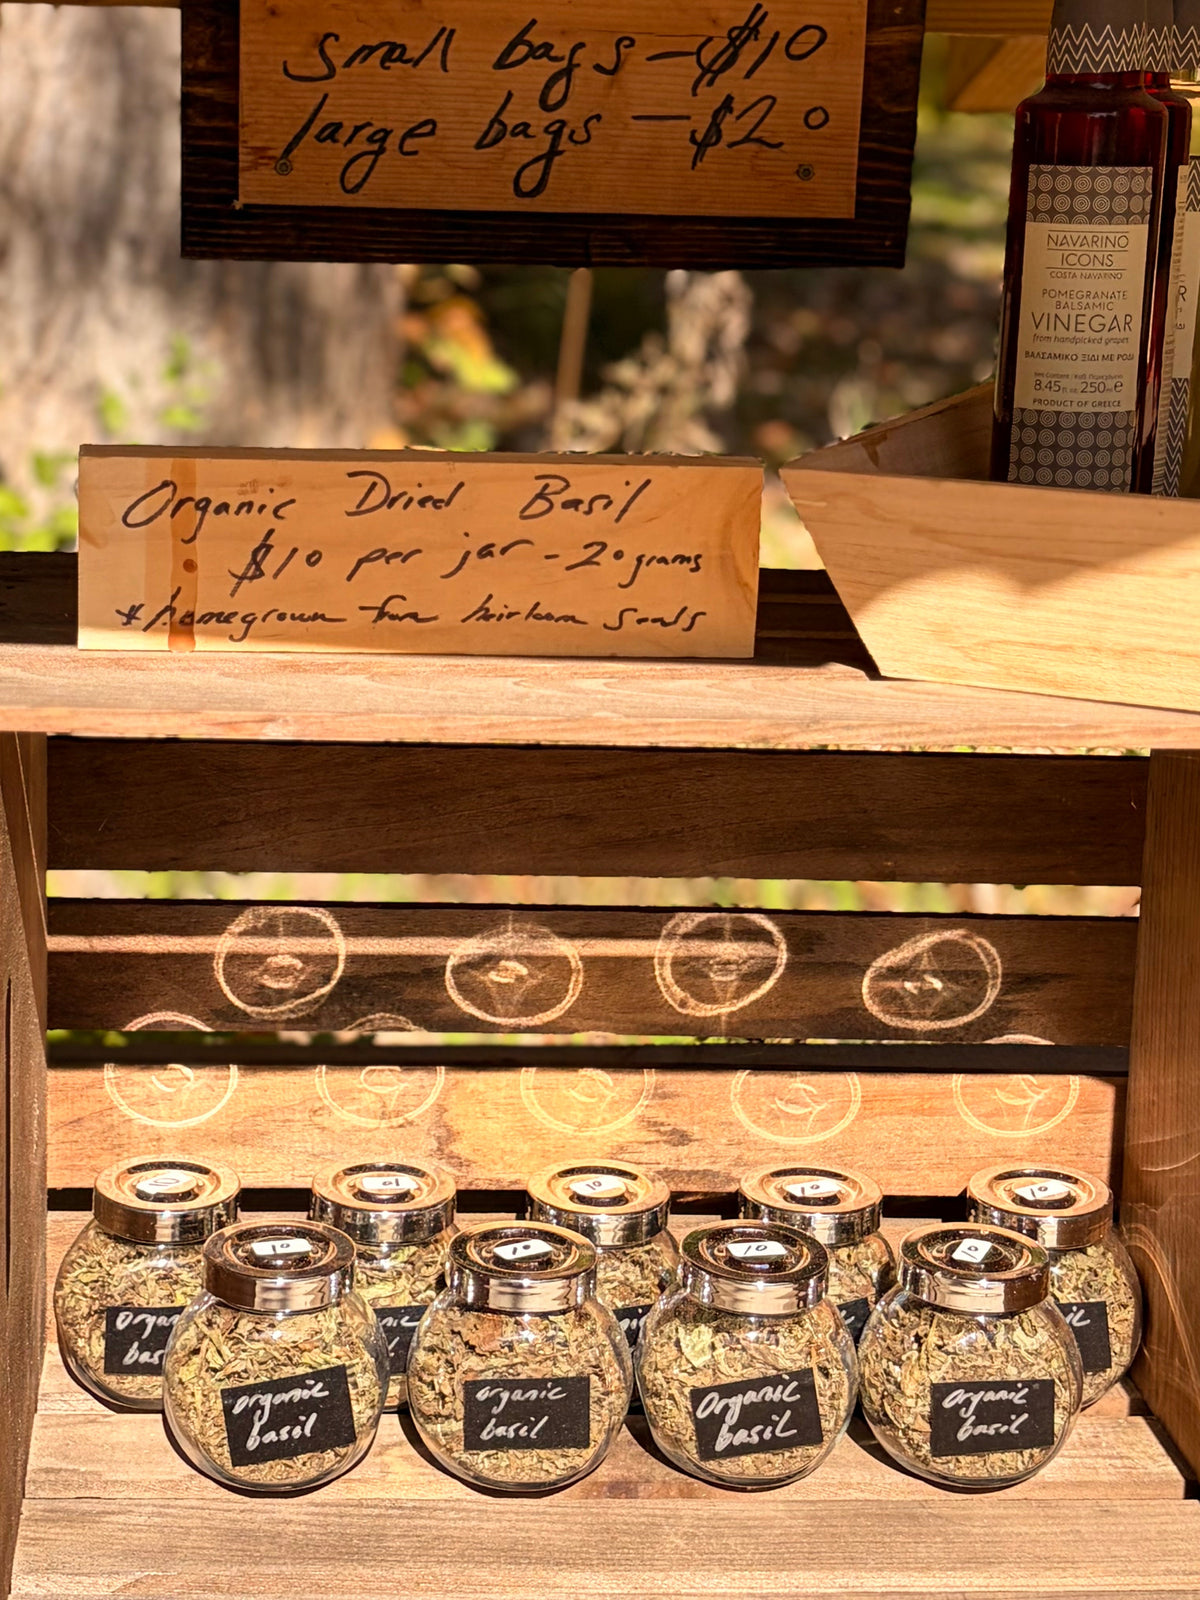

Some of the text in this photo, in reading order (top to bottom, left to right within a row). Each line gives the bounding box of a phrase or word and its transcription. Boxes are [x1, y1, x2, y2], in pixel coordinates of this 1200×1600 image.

[492, 18, 636, 112] bags
[474, 90, 603, 199] bags
[1047, 234, 1130, 249] NAVARINO
[1061, 252, 1114, 267] ICONS
[1049, 271, 1123, 280] COSTA NAVARINO
[1042, 288, 1128, 301] POMEGRANATE
[1055, 300, 1114, 311] BALSAMIC
[1031, 311, 1133, 333] VINEGAR
[1033, 333, 1052, 344] from
[1054, 335, 1103, 345] handpicked
[1033, 378, 1061, 393] 8.45
[1033, 398, 1074, 407] PRODUCT
[1091, 400, 1121, 408] GREECE
[121, 470, 652, 544] Organic Dried Basil
[227, 527, 323, 598] $10
[345, 547, 423, 582] per
[440, 531, 535, 579] jar
[148, 1176, 181, 1188] 10
[586, 1179, 603, 1191] 10
[800, 1183, 821, 1195] 10
[1030, 1185, 1049, 1199] 10
[270, 1242, 291, 1255] 10
[744, 1244, 768, 1255] 10
[122, 1341, 165, 1366] bas
[245, 1409, 318, 1451] basil
[479, 1415, 549, 1441] basil
[714, 1409, 798, 1452] basil
[956, 1413, 1030, 1442] basil
